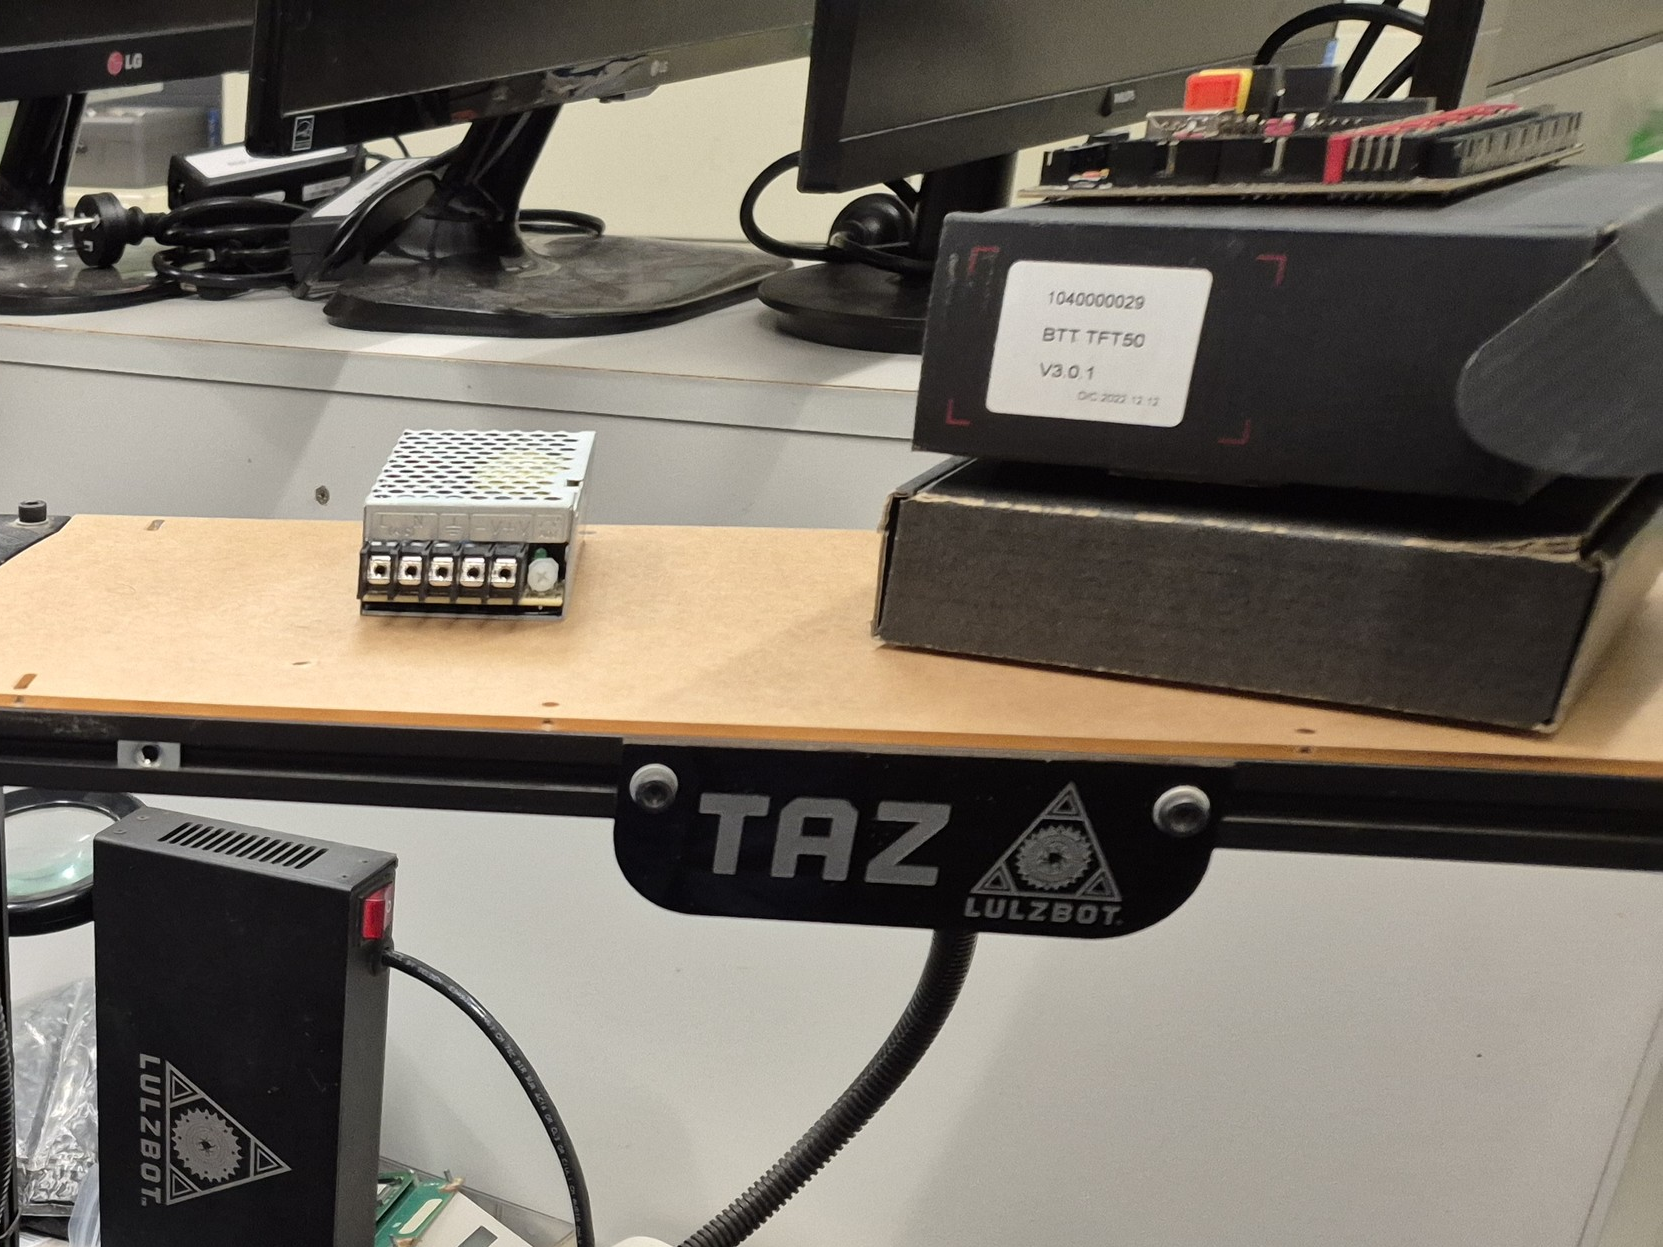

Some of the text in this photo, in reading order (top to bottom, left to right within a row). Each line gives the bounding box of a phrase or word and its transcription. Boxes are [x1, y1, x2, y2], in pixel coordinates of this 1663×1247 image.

[125, 53, 142, 70] LG
[1048, 291, 1145, 310] 1040000029
[1042, 327, 1145, 348] BTT TFT50
[1040, 363, 1095, 380] V3.0.1
[700, 792, 952, 886] TAZ
[964, 898, 1117, 926] LULZBOT
[139, 1053, 163, 1205] LULZBOT
